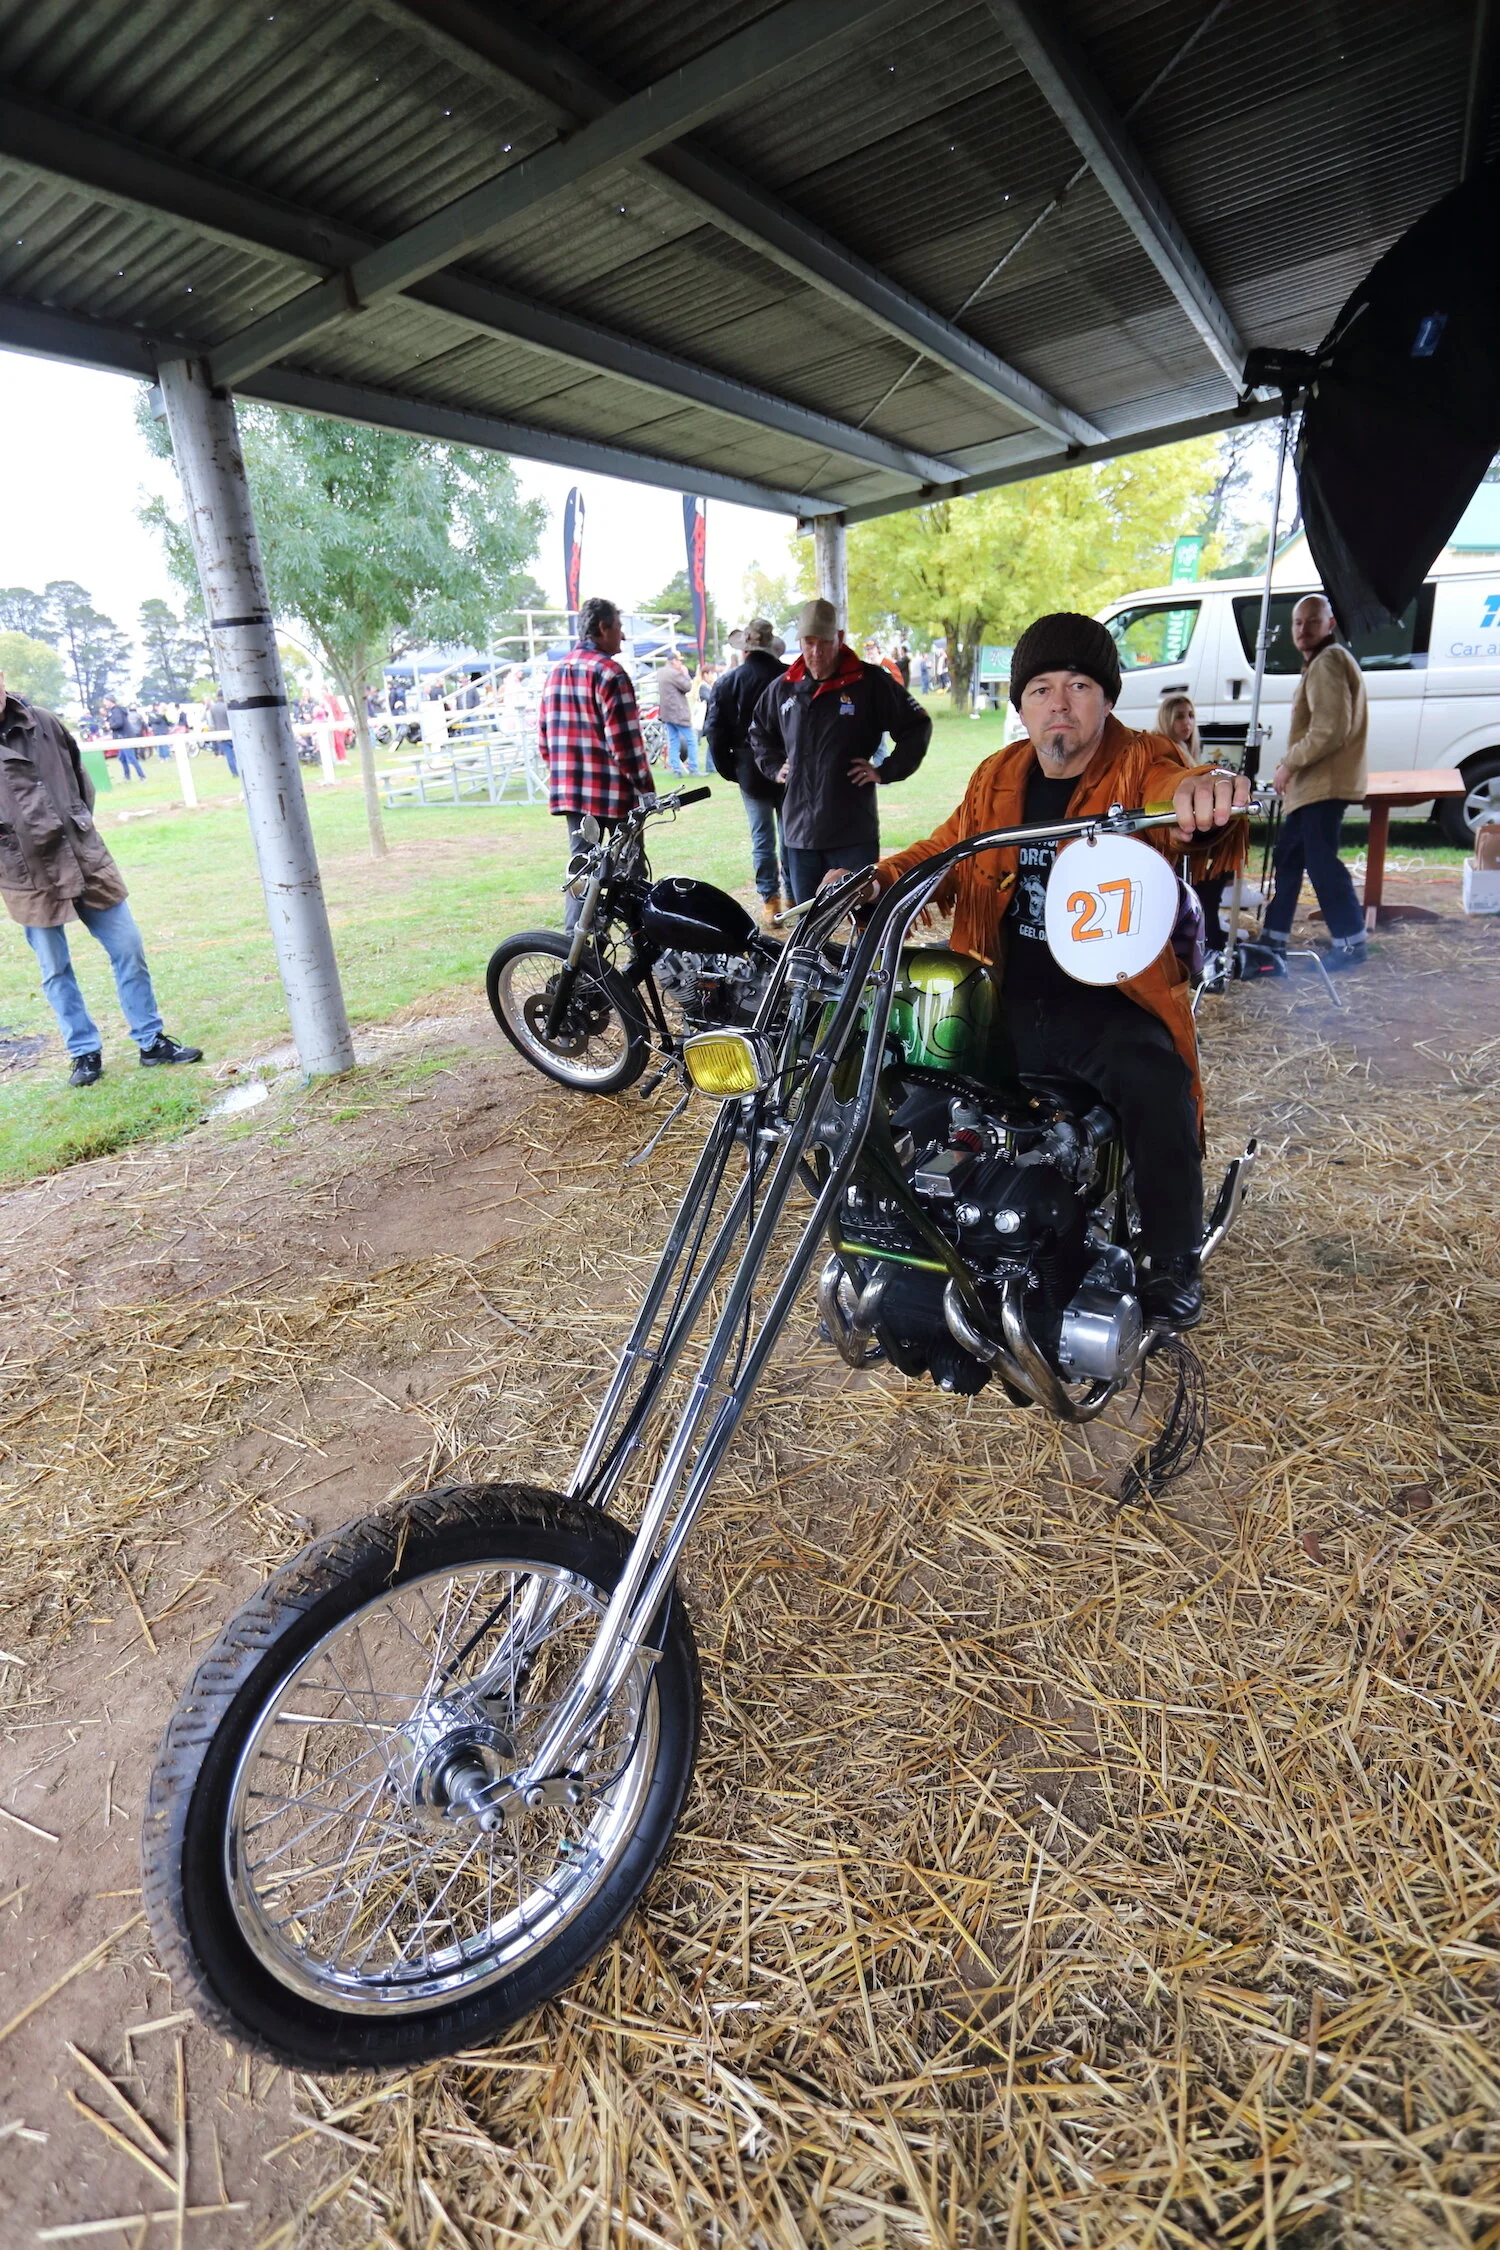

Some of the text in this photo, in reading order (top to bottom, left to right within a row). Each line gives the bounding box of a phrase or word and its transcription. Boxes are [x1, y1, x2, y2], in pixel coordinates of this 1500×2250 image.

[1450, 642, 1500, 656] Car a
[1066, 878, 1142, 943] 27
